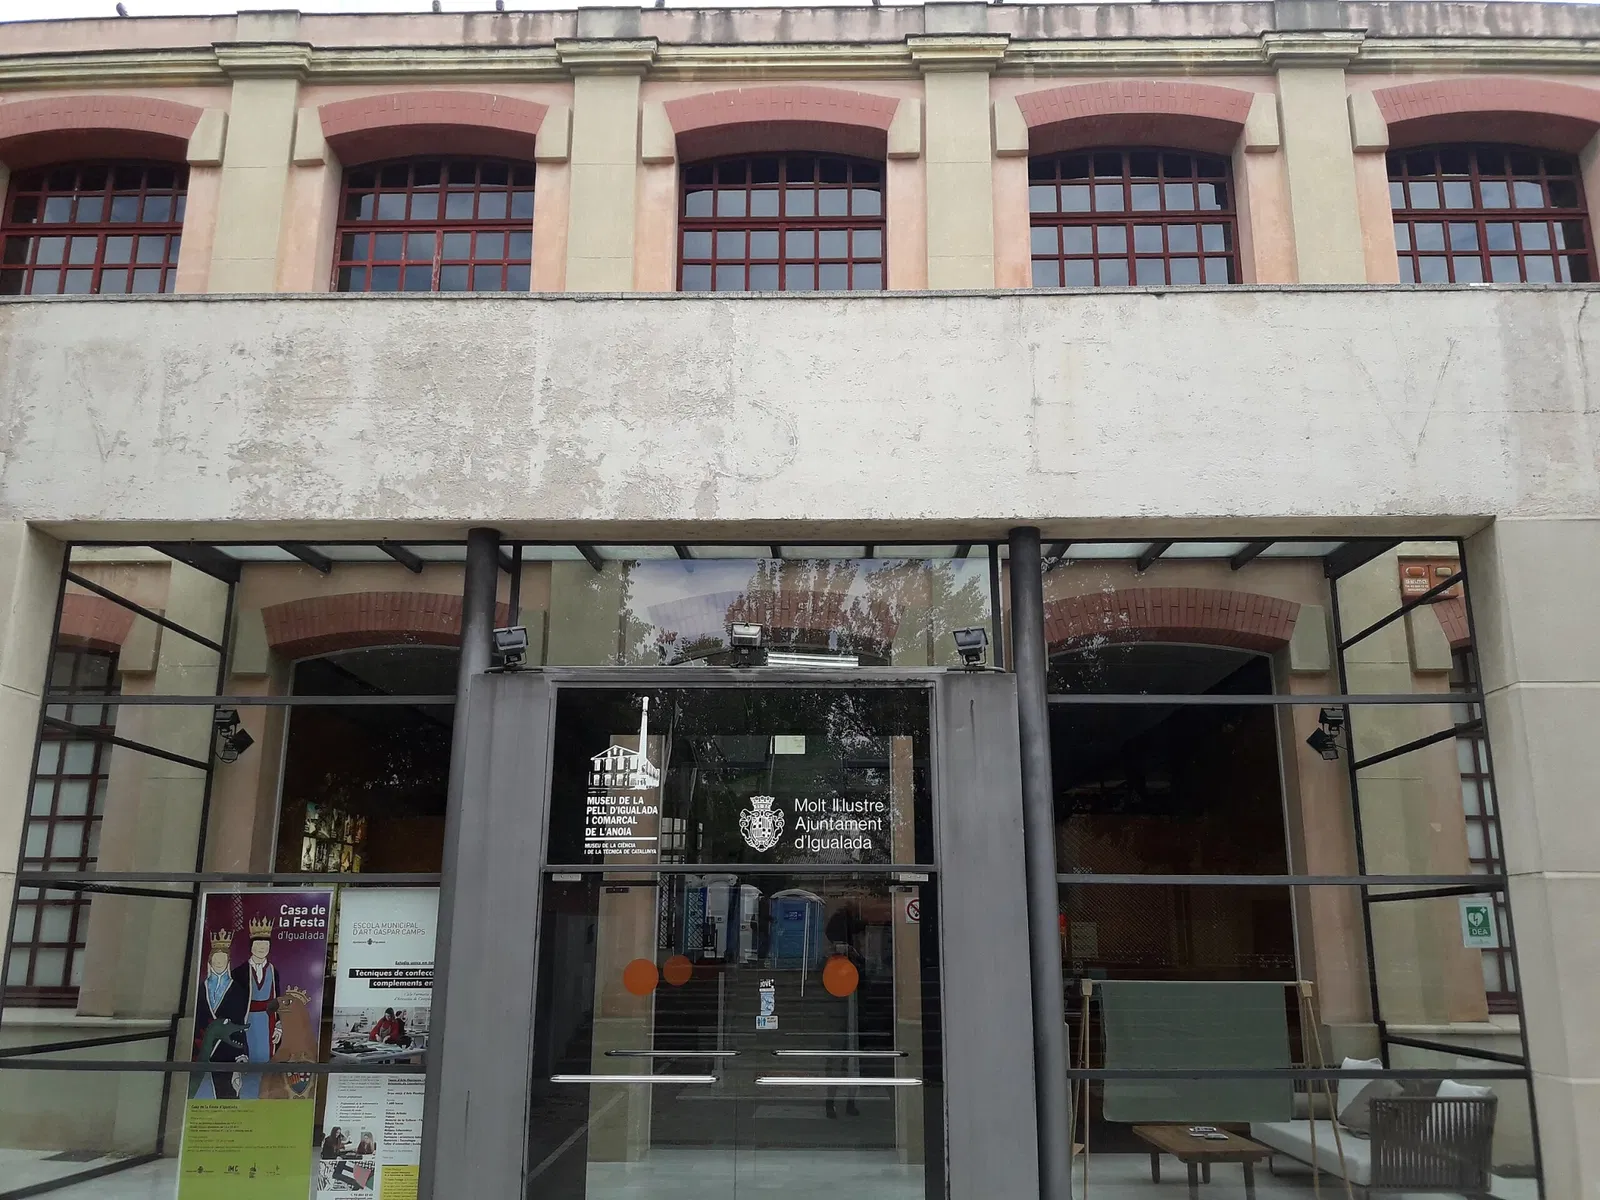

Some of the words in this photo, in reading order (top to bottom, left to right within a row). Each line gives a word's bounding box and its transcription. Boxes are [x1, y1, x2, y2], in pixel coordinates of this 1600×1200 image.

[586, 796, 616, 805] MUSEU
[619, 796, 630, 805] DE
[633, 796, 644, 805] LA
[794, 798, 826, 812] Molt
[586, 806, 607, 815] PELL
[610, 805, 658, 815] D'IGUALADA
[585, 816, 589, 825] I
[591, 816, 638, 825] COMARCAL
[795, 816, 882, 833] Ajuntament
[585, 827, 597, 836] DE
[599, 827, 632, 836] L'ANOIA
[794, 834, 872, 852] d'Igualada
[280, 904, 308, 915] Casa
[311, 904, 326, 915] de
[279, 916, 290, 927] la
[293, 917, 325, 927] Festa
[277, 930, 325, 942] d'Igualada
[355, 969, 392, 978] Tècniques
[373, 979, 422, 988] complements
